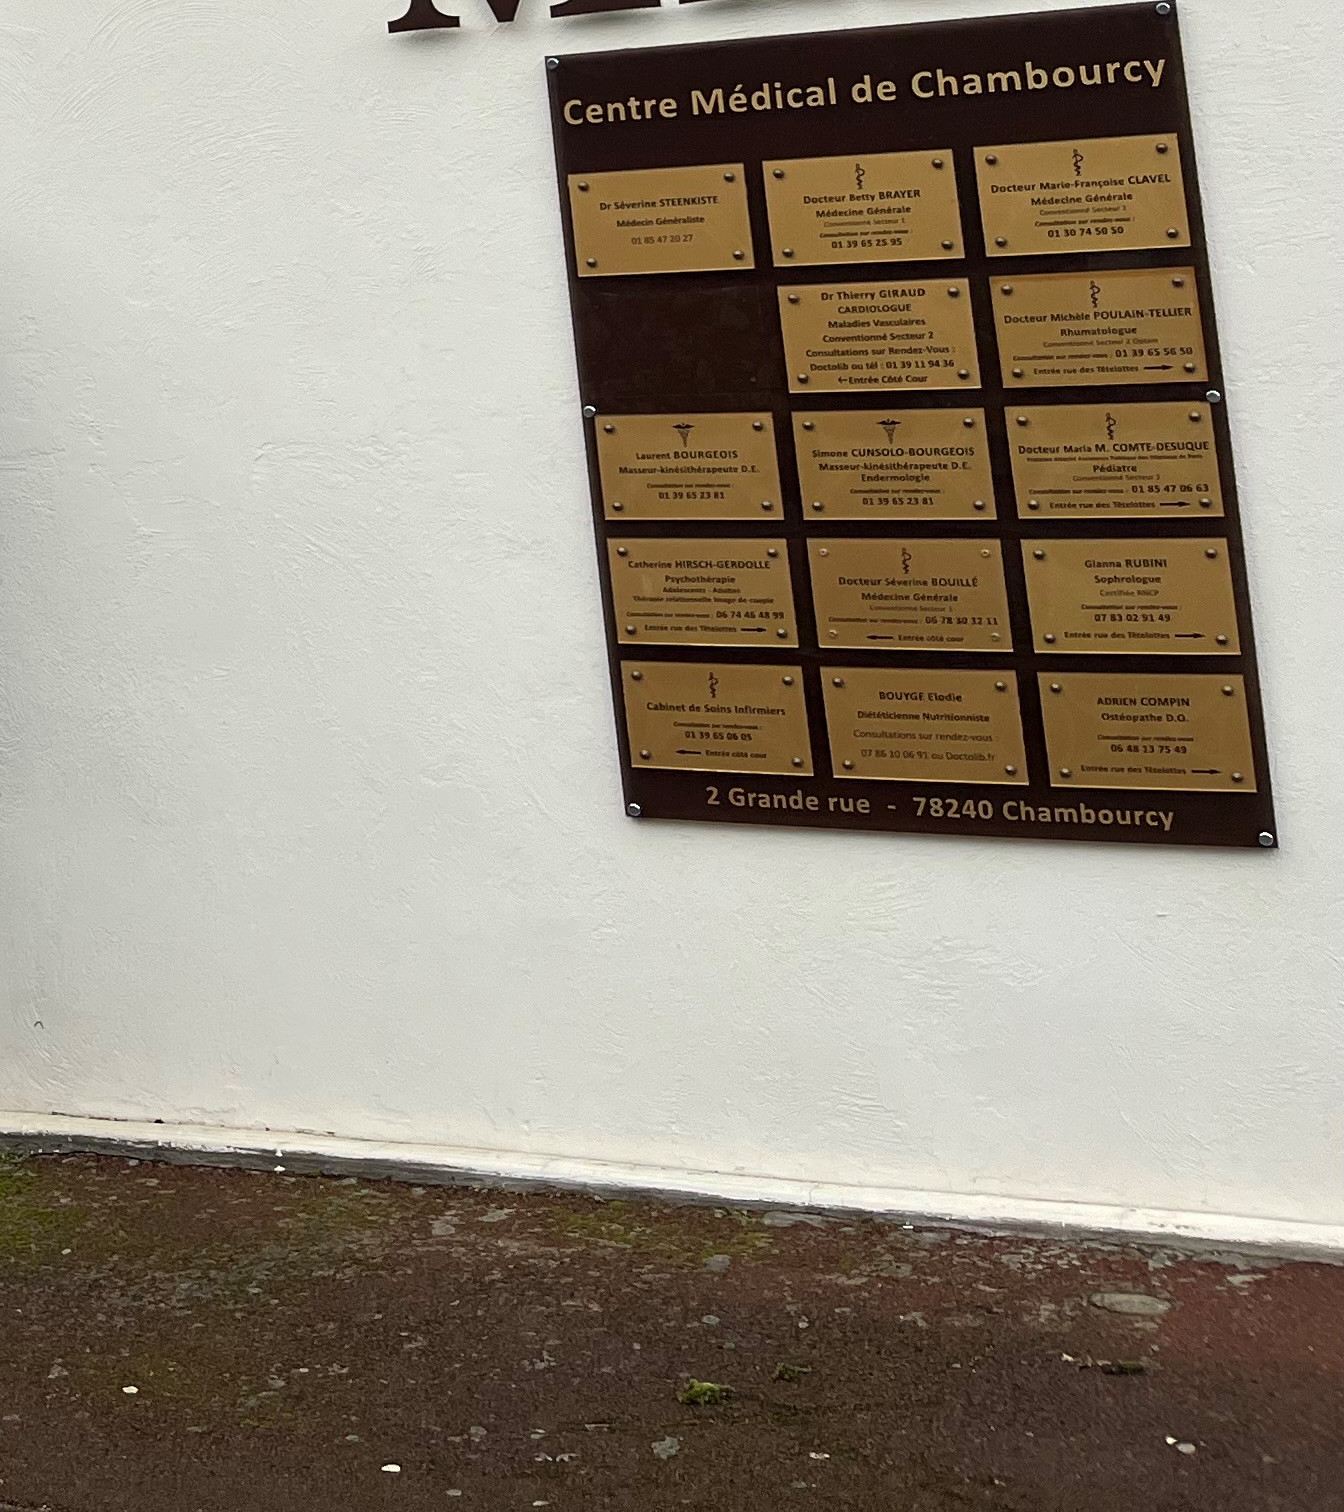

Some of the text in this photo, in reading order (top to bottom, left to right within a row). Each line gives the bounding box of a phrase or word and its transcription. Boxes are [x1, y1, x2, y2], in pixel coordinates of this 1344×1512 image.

[563, 55, 1167, 126] Centre Médical de Chambourcy
[990, 181, 1035, 194] Docteur
[1127, 173, 1172, 186] CLAVEL
[599, 201, 611, 211] Dr
[658, 195, 719, 208] STEENKISTE
[803, 193, 845, 205] Docteur
[878, 189, 921, 200] BRAYER
[820, 292, 833, 301] Dr
[878, 288, 926, 299] GIRAUD
[1003, 313, 1047, 324] Docteur
[672, 450, 739, 460] BOURGEOIS
[706, 787, 721, 806] 2
[728, 788, 819, 811] Grande
[828, 796, 870, 814] rue
[912, 797, 994, 820] 78240
[1003, 799, 1175, 831] Chambourcy
